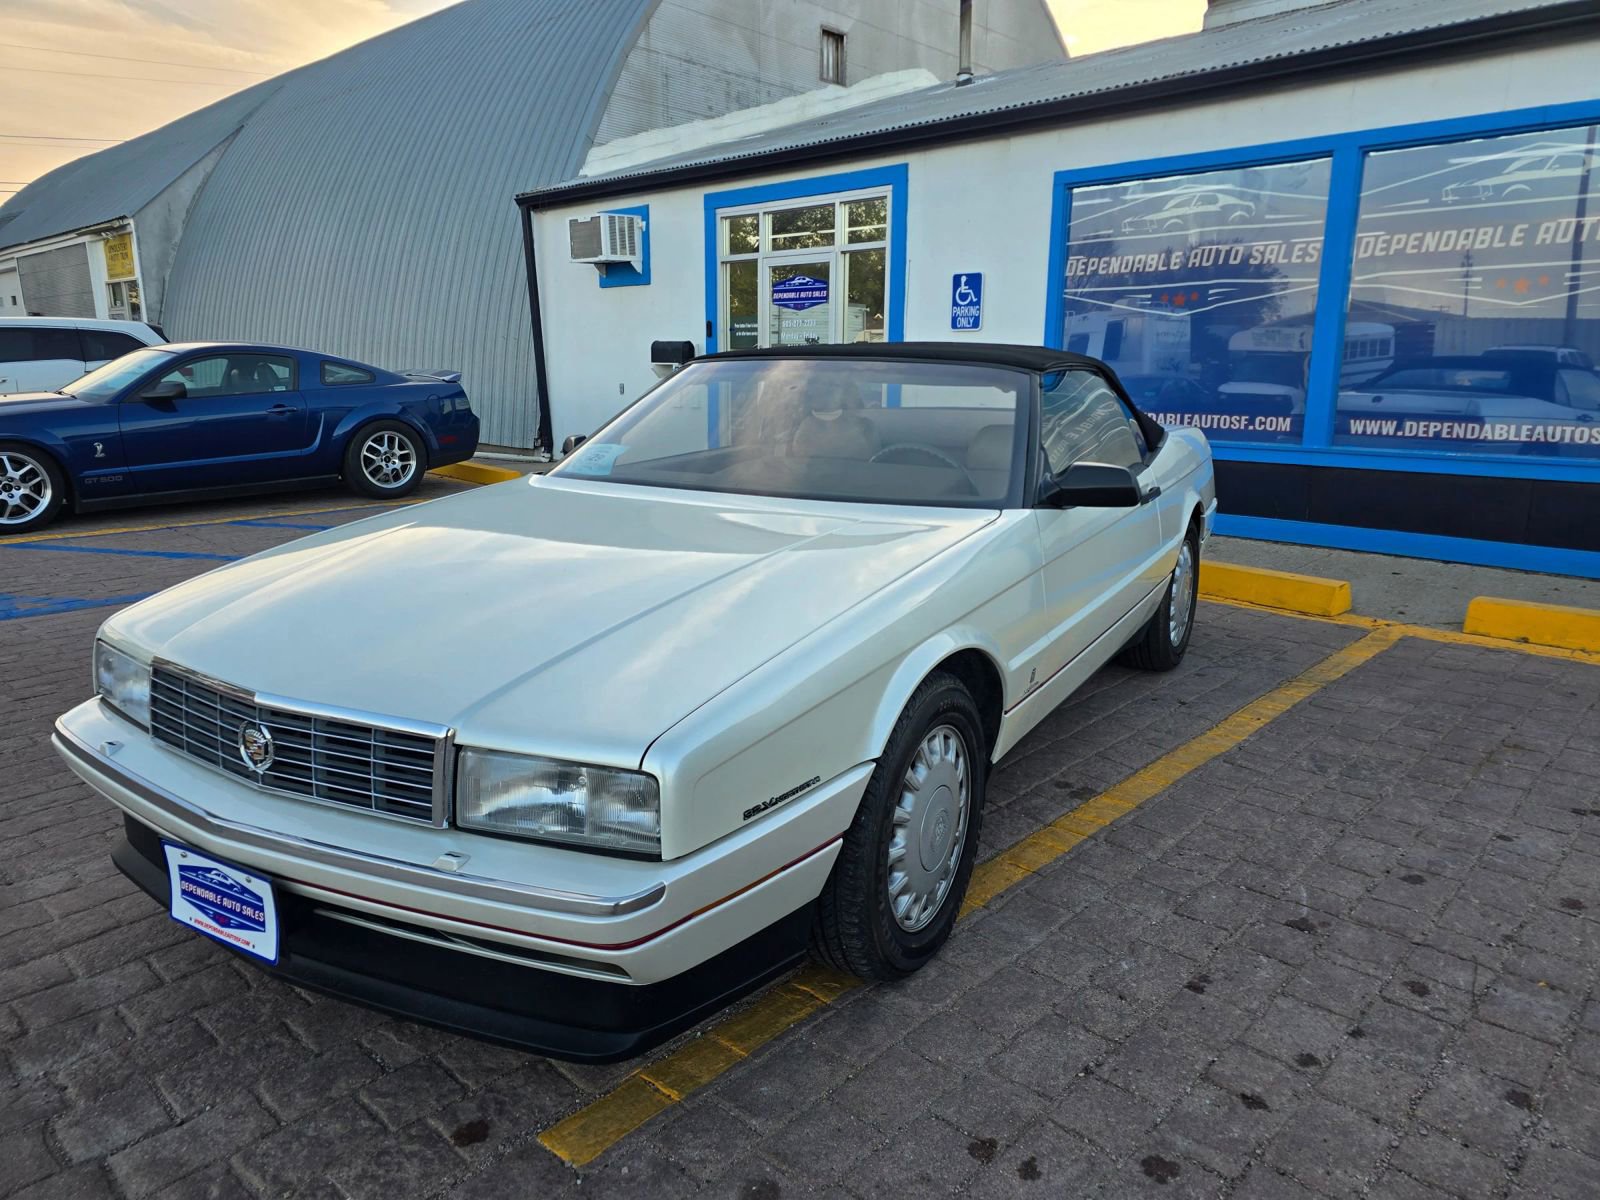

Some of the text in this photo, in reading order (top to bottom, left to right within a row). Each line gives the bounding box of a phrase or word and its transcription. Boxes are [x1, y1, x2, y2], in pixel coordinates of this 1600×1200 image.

[1358, 219, 1600, 259] DEPENDABLE AUT
[1065, 242, 1323, 277] DEPENDABLE AUTO SALES
[952, 305, 980, 317] PARKING
[956, 316, 975, 328] ONLY
[1144, 412, 1291, 432] DABLEAUTOSF.COM
[181, 880, 264, 922] DEPENDABLE AUTO SALES
